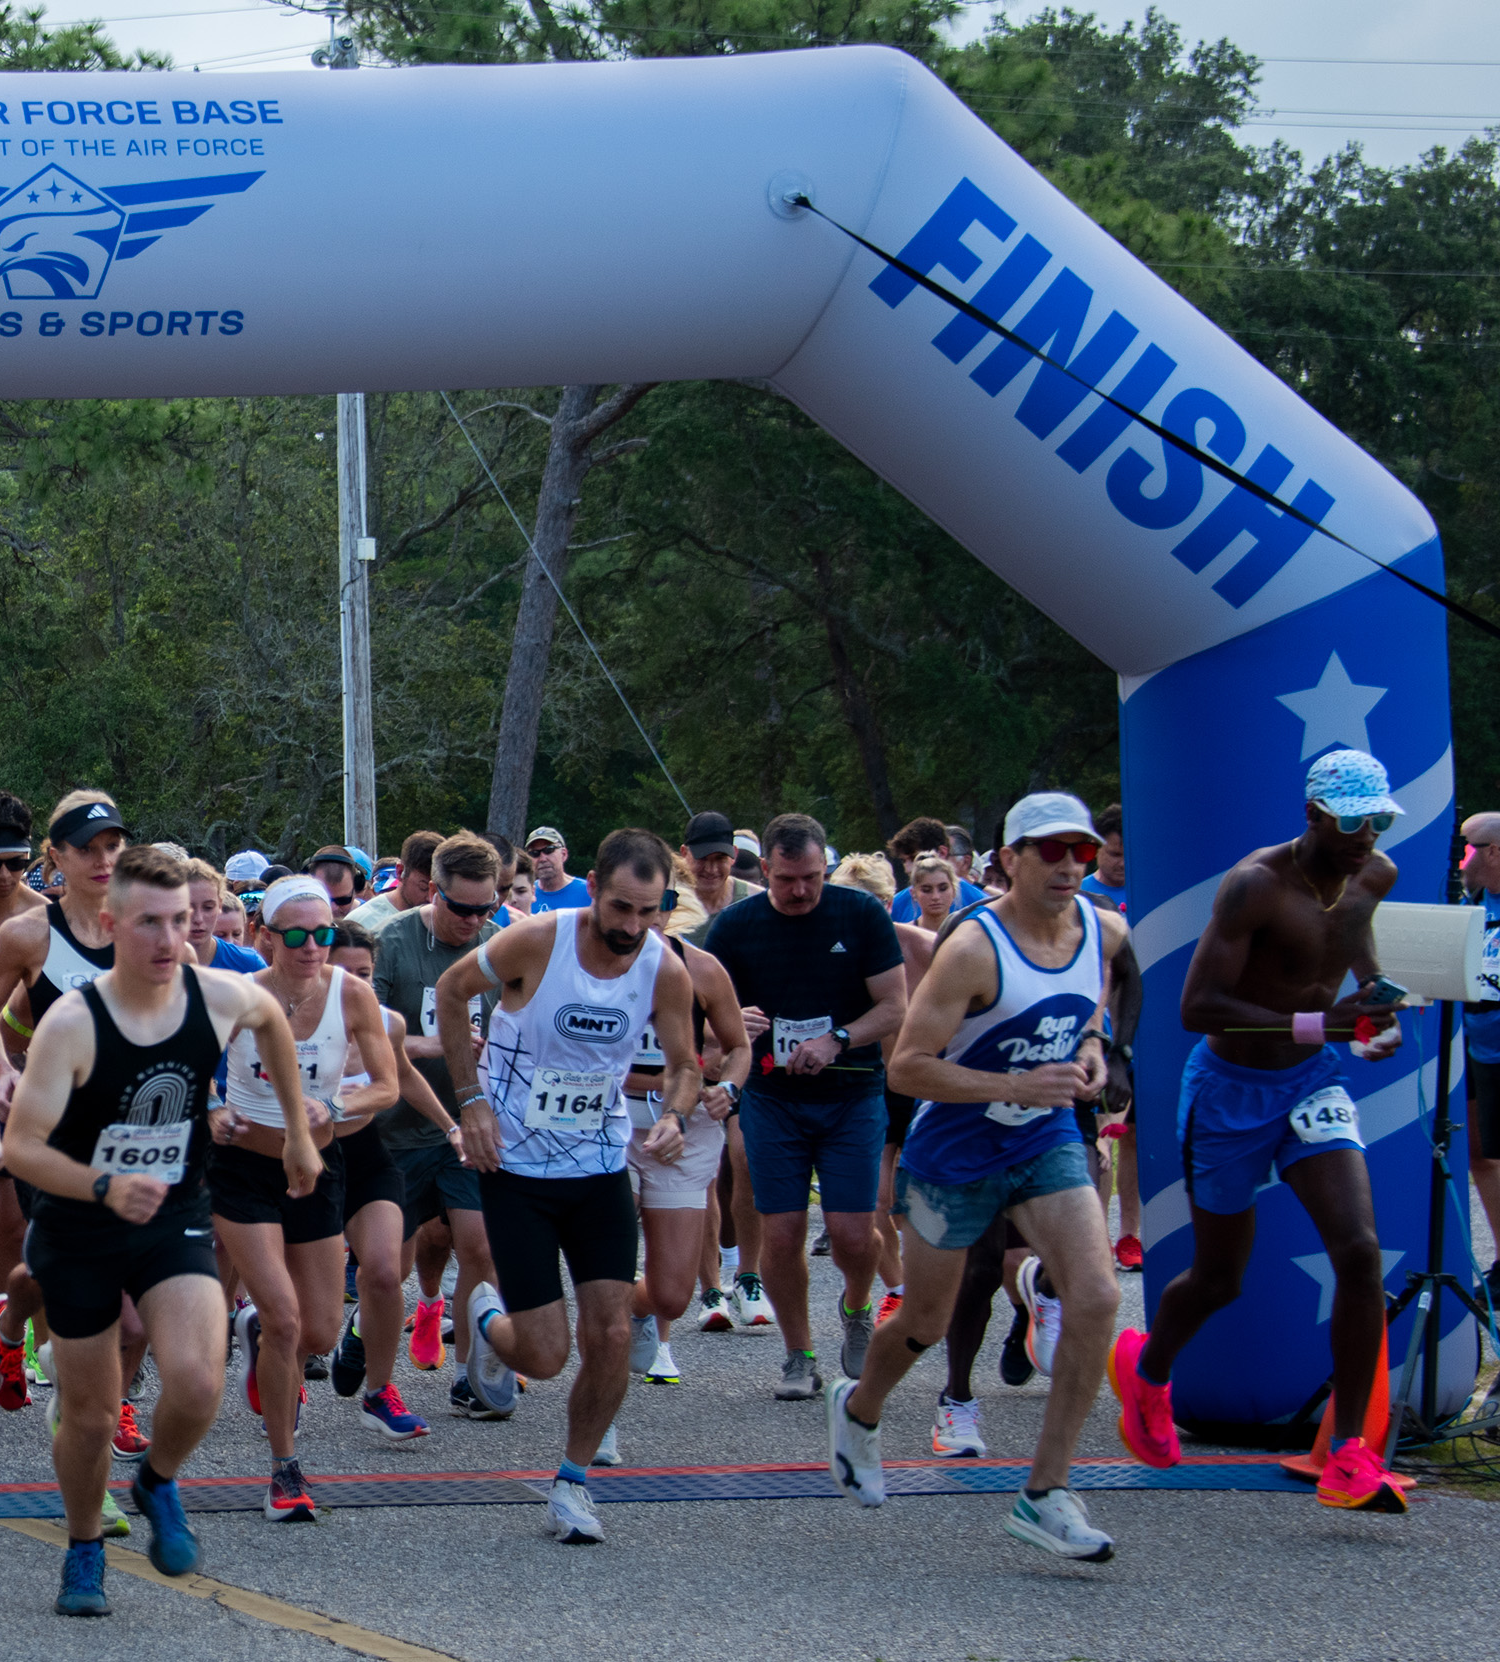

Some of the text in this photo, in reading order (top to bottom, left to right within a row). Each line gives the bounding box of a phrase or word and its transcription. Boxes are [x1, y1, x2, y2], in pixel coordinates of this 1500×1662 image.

[23, 101, 162, 125] FORCE
[172, 100, 284, 125] BASE
[21, 139, 56, 156] OF
[63, 139, 116, 156] THE
[126, 138, 168, 156] AIR
[176, 138, 265, 156] FORCE
[38, 312, 66, 337] &
[79, 310, 245, 336] SPORTS
[867, 176, 1336, 610] FINISH
[426, 1008, 482, 1028] 16
[567, 1014, 619, 1034] MNT
[1033, 1015, 1077, 1039] Run
[997, 1031, 1079, 1063] Desti
[250, 1061, 318, 1080] 11
[535, 1091, 603, 1115] 1164
[1296, 1107, 1360, 1129] 148
[101, 1145, 180, 1166] 1609
